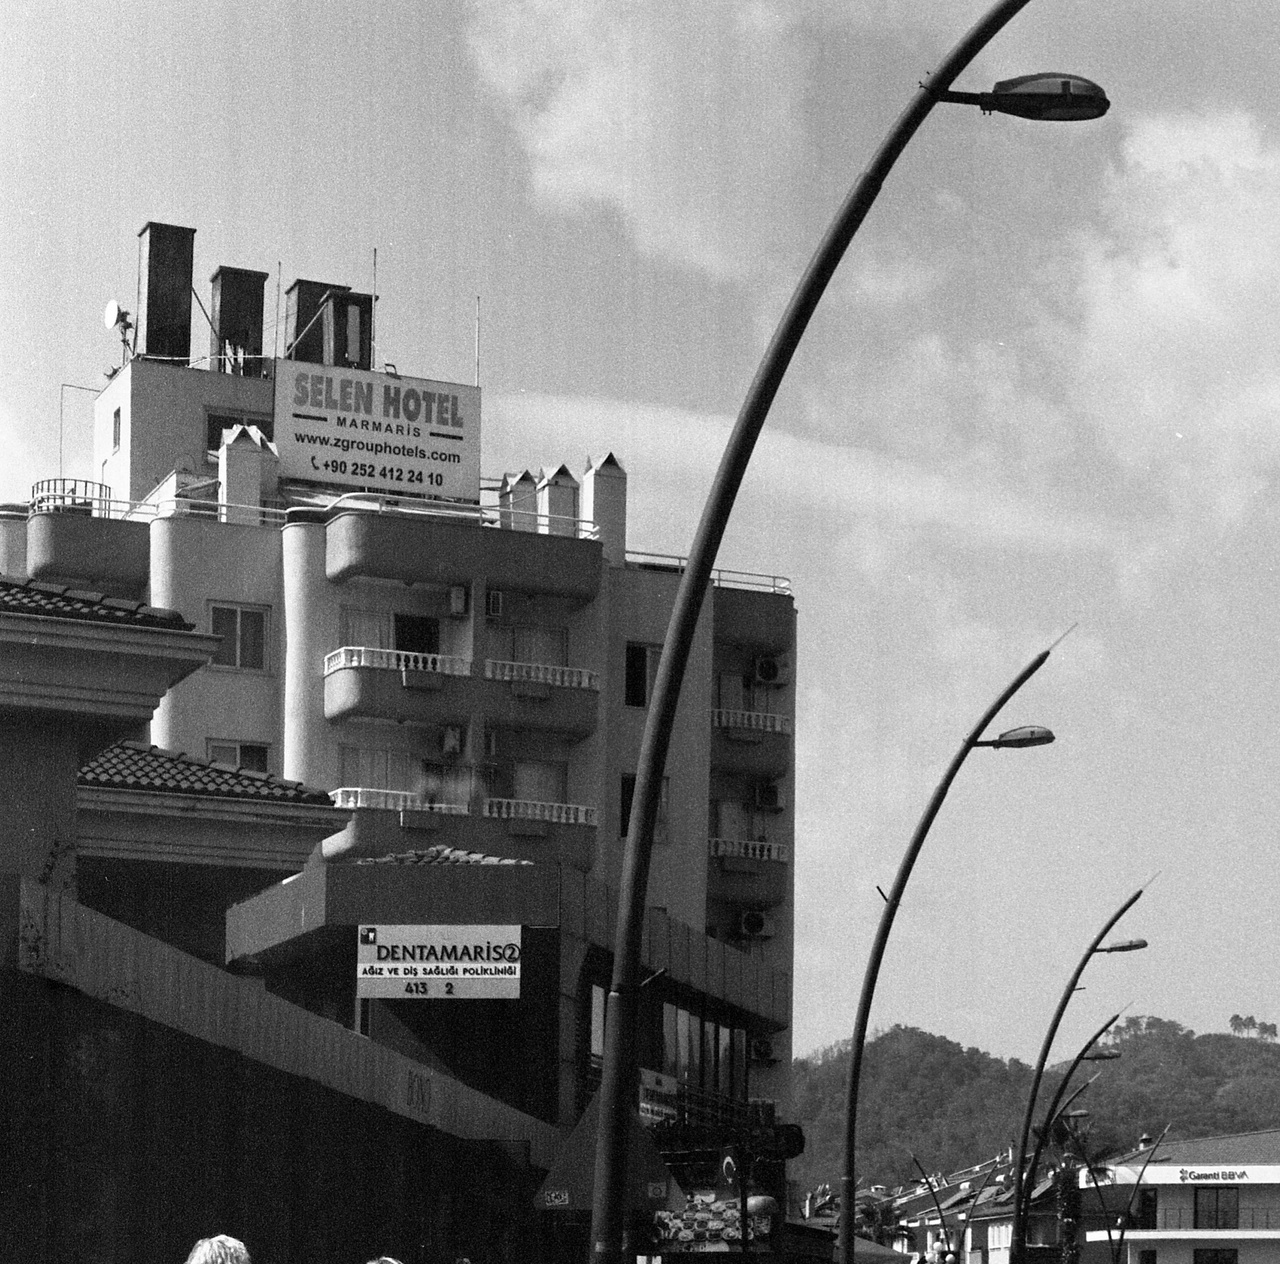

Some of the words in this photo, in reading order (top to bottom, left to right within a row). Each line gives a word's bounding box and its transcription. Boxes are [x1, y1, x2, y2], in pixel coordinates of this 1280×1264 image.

[292, 372, 374, 416] SELEN
[382, 384, 464, 428] HOTEL
[336, 416, 421, 438] MARMARİS
[294, 432, 461, 464] www.zgrouphotels.com
[323, 459, 347, 475] +90
[350, 462, 376, 478] 252
[379, 465, 403, 482] 412
[407, 469, 423, 484] 24
[428, 472, 444, 487] 10
[362, 965, 384, 976] AĞIZ
[387, 967, 399, 976] VE
[403, 965, 418, 977] DİŞ
[422, 965, 459, 976] SAĞLIĞI
[404, 981, 428, 995] 413
[445, 981, 455, 995] 2
[1189, 1170, 1220, 1181] Garanti
[1221, 1170, 1250, 1181] BBVA
